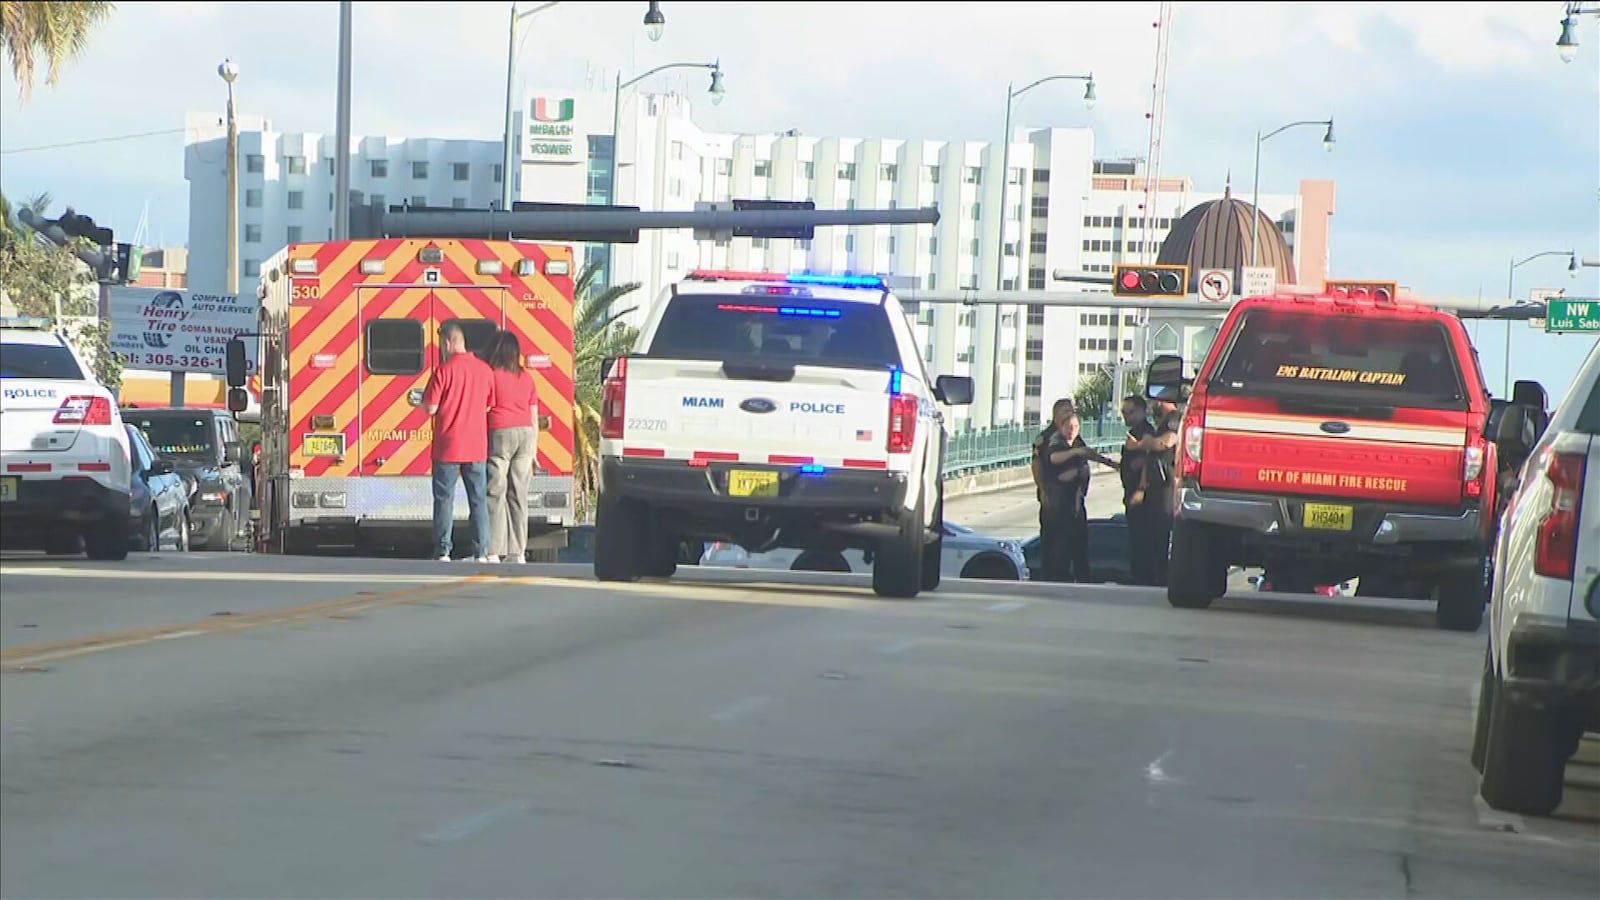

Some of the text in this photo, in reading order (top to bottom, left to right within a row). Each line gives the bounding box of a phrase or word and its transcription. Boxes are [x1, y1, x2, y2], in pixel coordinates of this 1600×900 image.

[292, 285, 320, 299] 530
[191, 294, 238, 304] COMPLETE
[143, 305, 190, 321] Henry
[191, 303, 254, 314] AUTO SERVICE
[1566, 302, 1590, 316] NW
[1551, 317, 1574, 328] Luis
[180, 324, 250, 335] GOMAS NUEVAS
[117, 332, 138, 341] OPEN
[195, 336, 200, 344] Y
[184, 345, 201, 353] OIL
[1276, 365, 1406, 385] EMS BATTALION CAPTAIN
[4, 389, 57, 398] POLICE
[682, 396, 845, 414] MIAMI POLICE
[628, 418, 667, 431] 223270
[367, 429, 433, 441] MIAMI FIR
[1258, 469, 1408, 491] CITY OF MIAMI FIRE RESCUE
